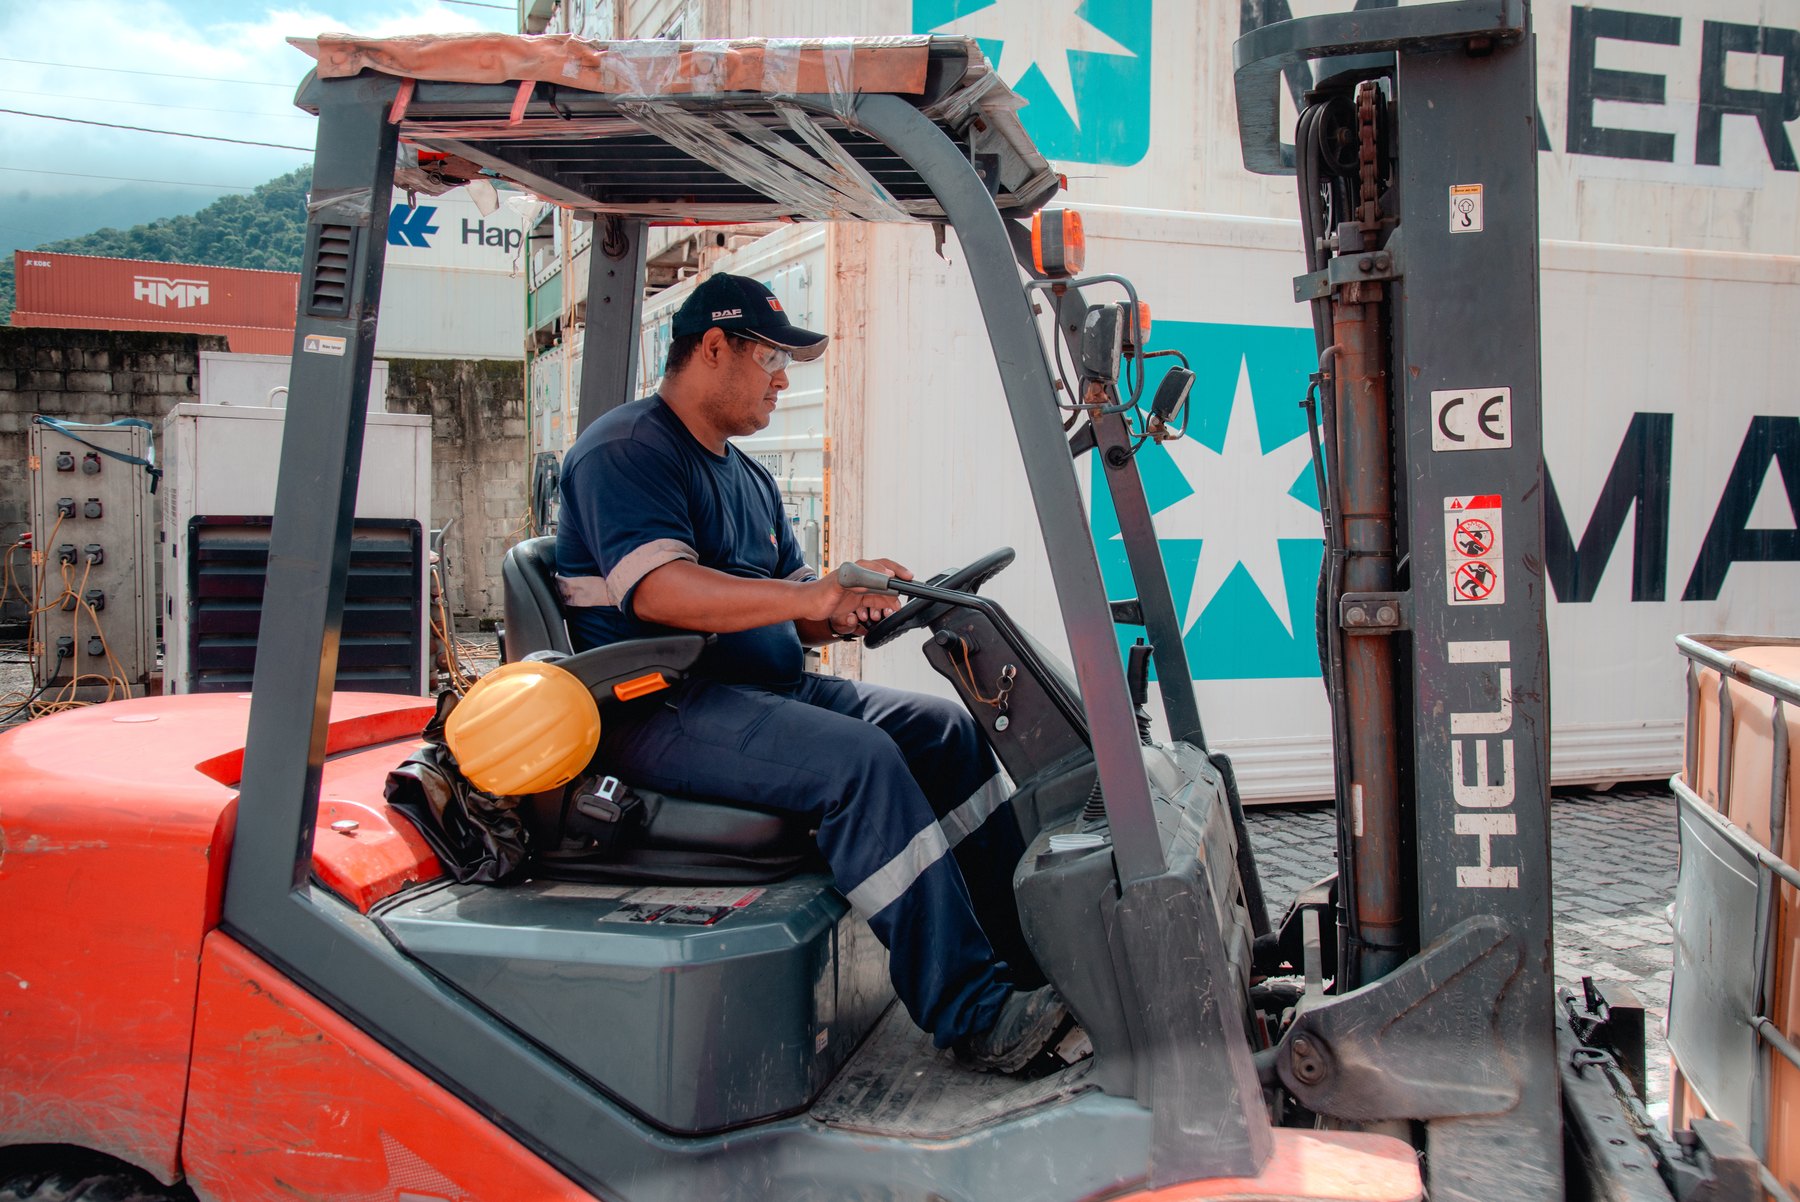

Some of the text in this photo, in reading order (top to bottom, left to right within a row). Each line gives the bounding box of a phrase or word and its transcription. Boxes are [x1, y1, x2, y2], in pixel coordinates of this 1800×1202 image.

[134, 275, 209, 308] HMM
[712, 308, 742, 320] DAF
[1438, 395, 1505, 442] CE
[1448, 640, 1519, 888] HELI
